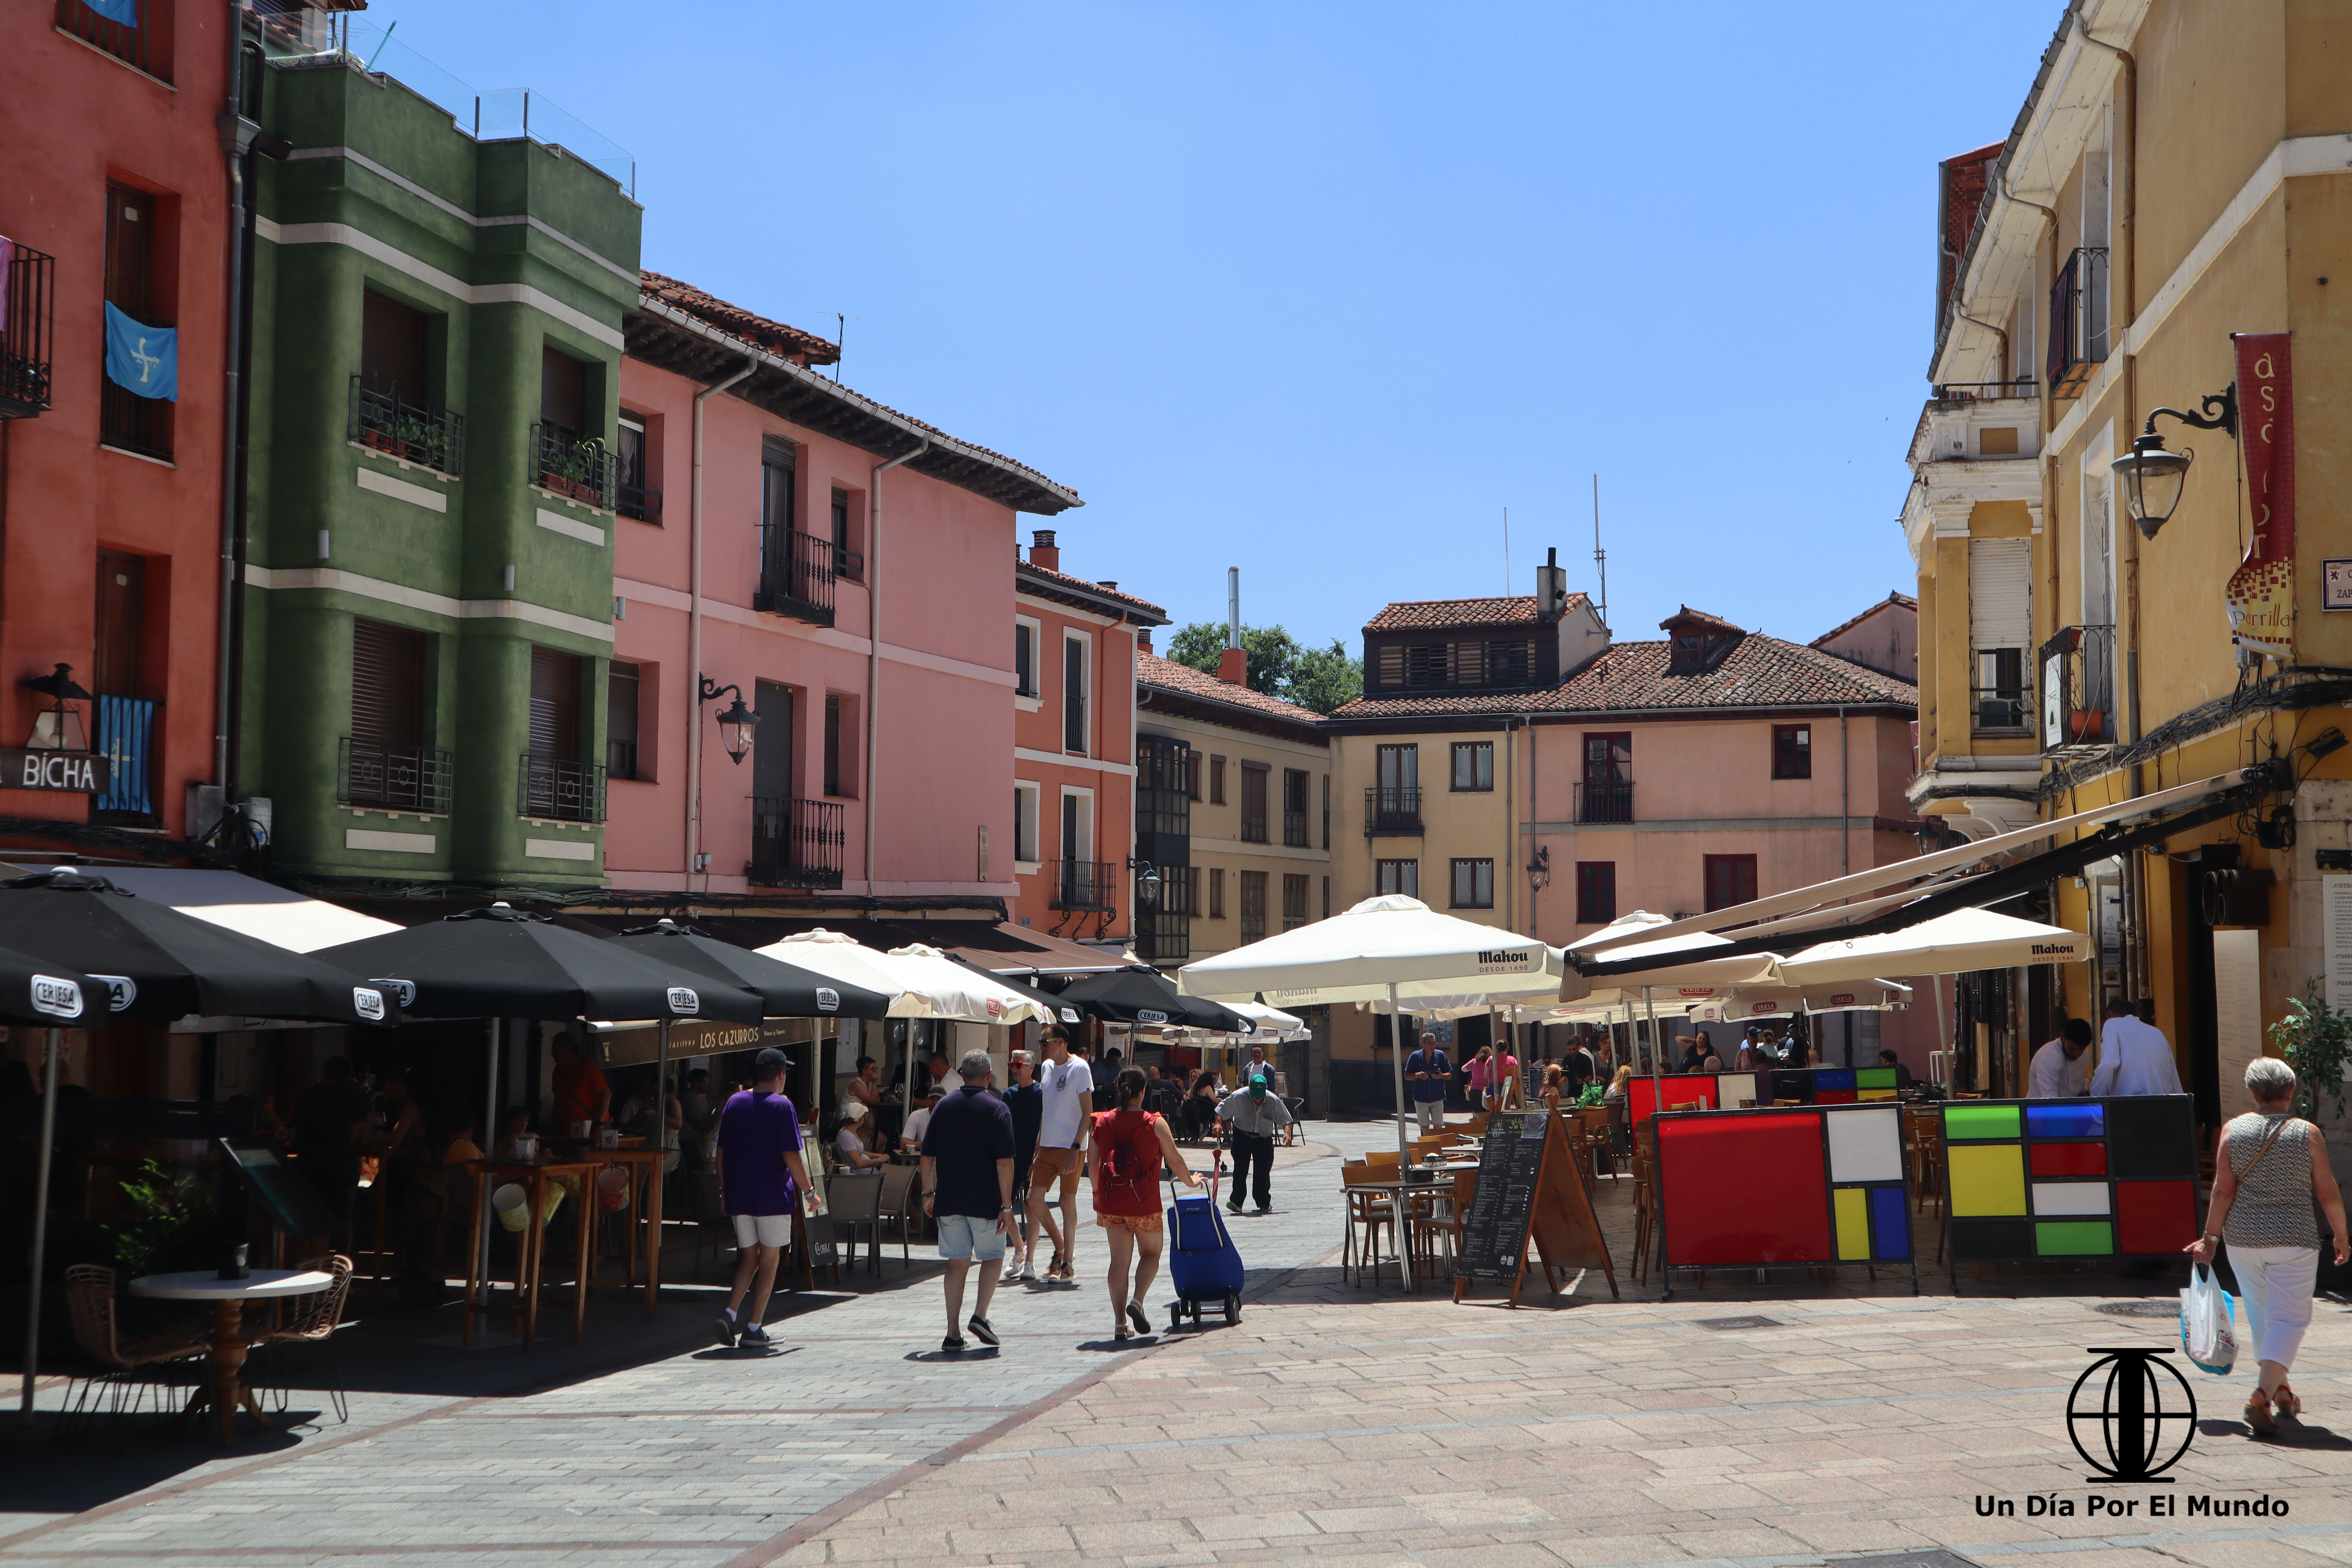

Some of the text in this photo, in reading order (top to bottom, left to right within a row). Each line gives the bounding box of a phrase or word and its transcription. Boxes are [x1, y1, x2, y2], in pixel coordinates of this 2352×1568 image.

[2232, 604, 2290, 626] Parrilla
[1478, 950, 1528, 964] Mahou
[2031, 944, 2074, 955] Mahou
[700, 1031, 716, 1049] LOS
[719, 1027, 759, 1047] CAZURROS
